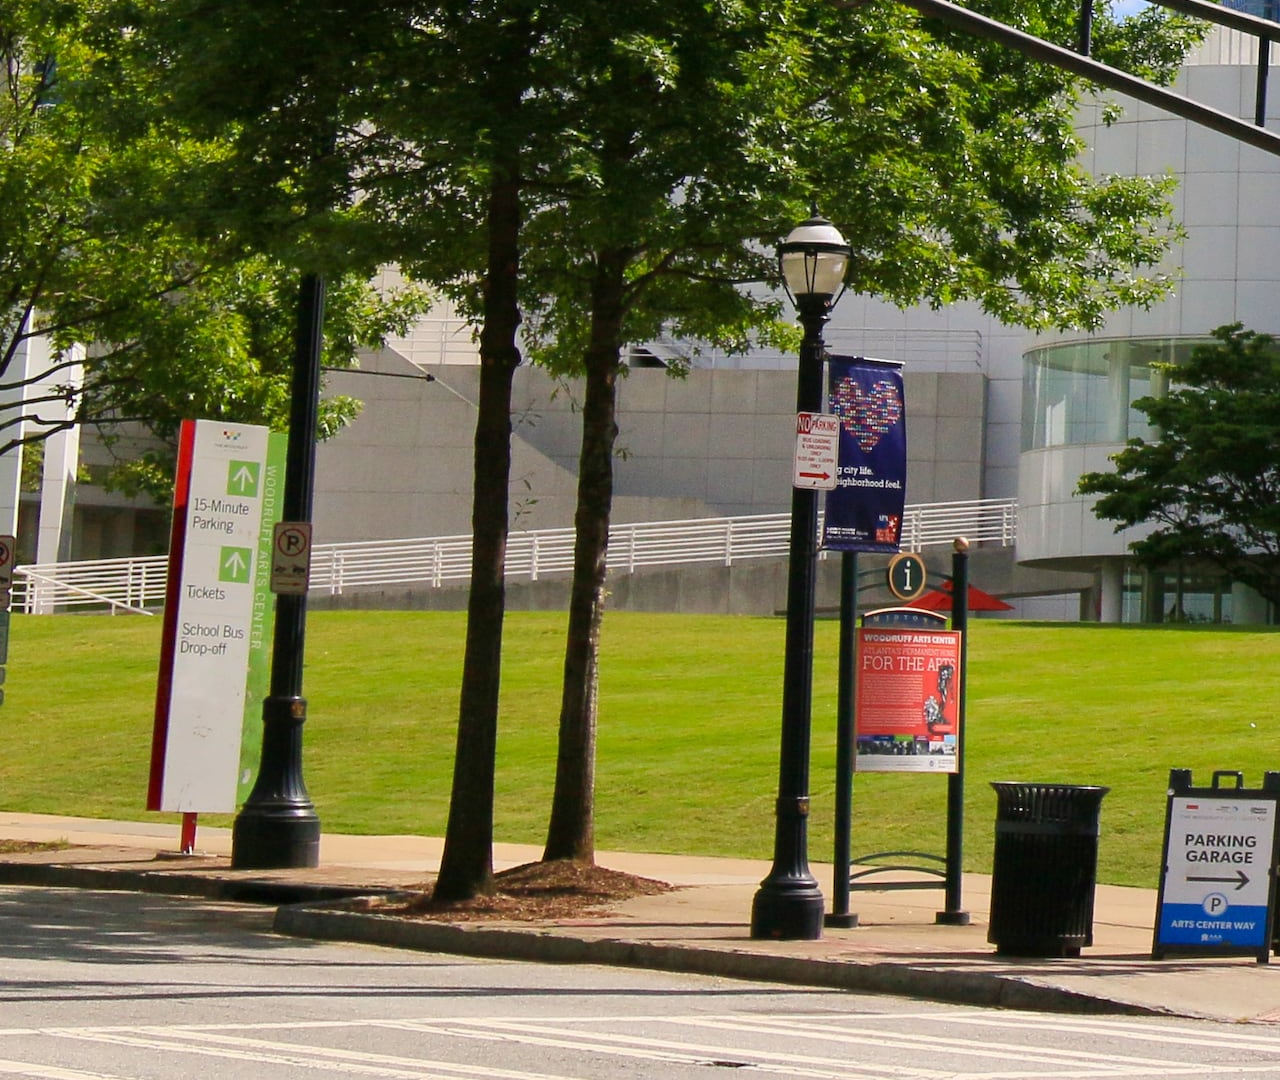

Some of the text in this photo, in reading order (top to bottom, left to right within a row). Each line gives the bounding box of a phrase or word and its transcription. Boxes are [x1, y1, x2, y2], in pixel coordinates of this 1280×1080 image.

[798, 416, 837, 432] NO PARKING
[844, 467, 858, 476] city
[859, 466, 874, 475] life.
[836, 477, 902, 489] eighborhood feel.
[194, 497, 249, 515] 15-Minute
[192, 516, 234, 534] Parking
[251, 465, 277, 649] WOODRUFF ARTS CENTER
[903, 560, 912, 591] i
[186, 584, 225, 600] Tickets
[873, 614, 938, 625] MIDTO
[182, 622, 244, 639] School Bus
[864, 634, 956, 644] WOODRUFF ARTS CENTER
[180, 640, 227, 656] Drop-off
[863, 655, 956, 672] FOR THE ARTS
[1185, 834, 1257, 848] PARKING
[1186, 850, 1253, 864] GARAGE
[1211, 898, 1221, 912] P
[1170, 920, 1256, 930] ARTS CENTER WAY
